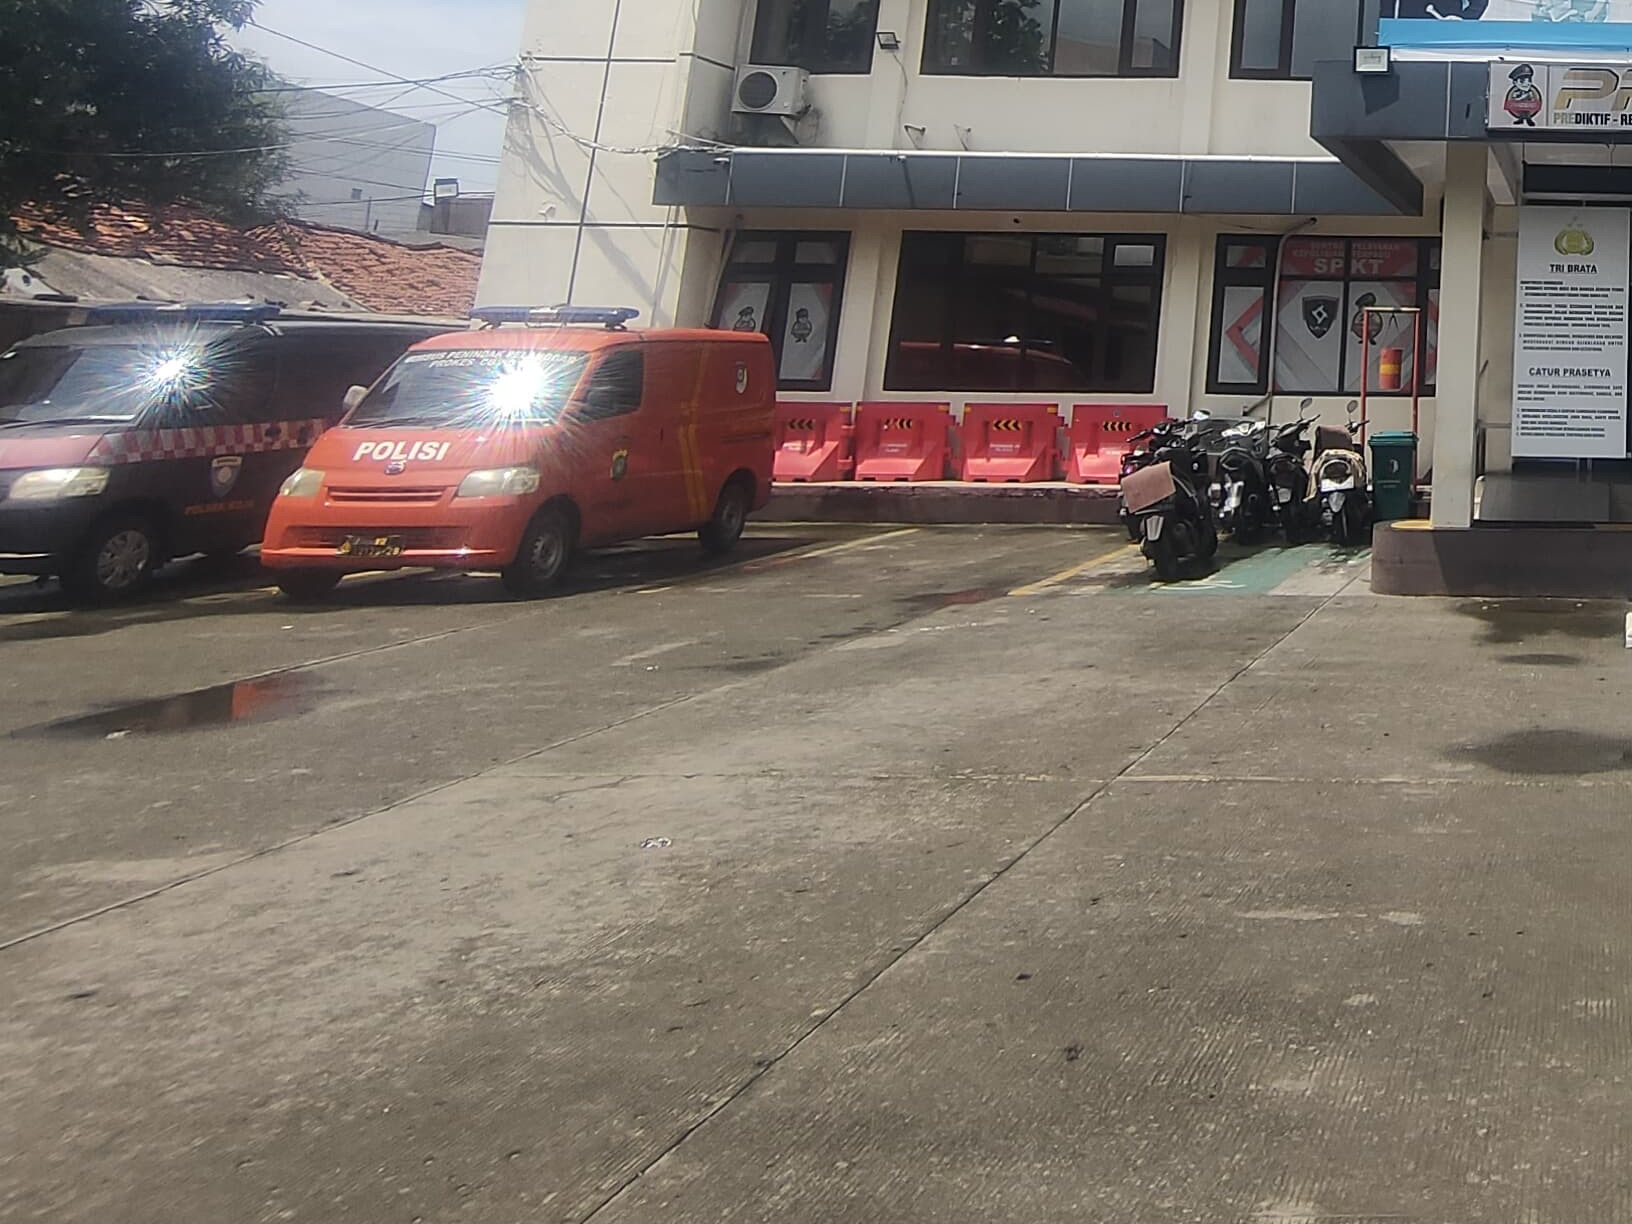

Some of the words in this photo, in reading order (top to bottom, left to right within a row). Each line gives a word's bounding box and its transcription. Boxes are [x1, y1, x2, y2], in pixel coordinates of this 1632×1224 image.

[1553, 113, 1611, 126] PREDIKTIF
[1313, 258, 1384, 274] SPKT
[1549, 264, 1565, 273] TRI
[1567, 264, 1597, 274] BRATA
[1529, 367, 1561, 376] CATUR
[1563, 368, 1611, 377] PRASETYA
[352, 441, 451, 461] POLISI
